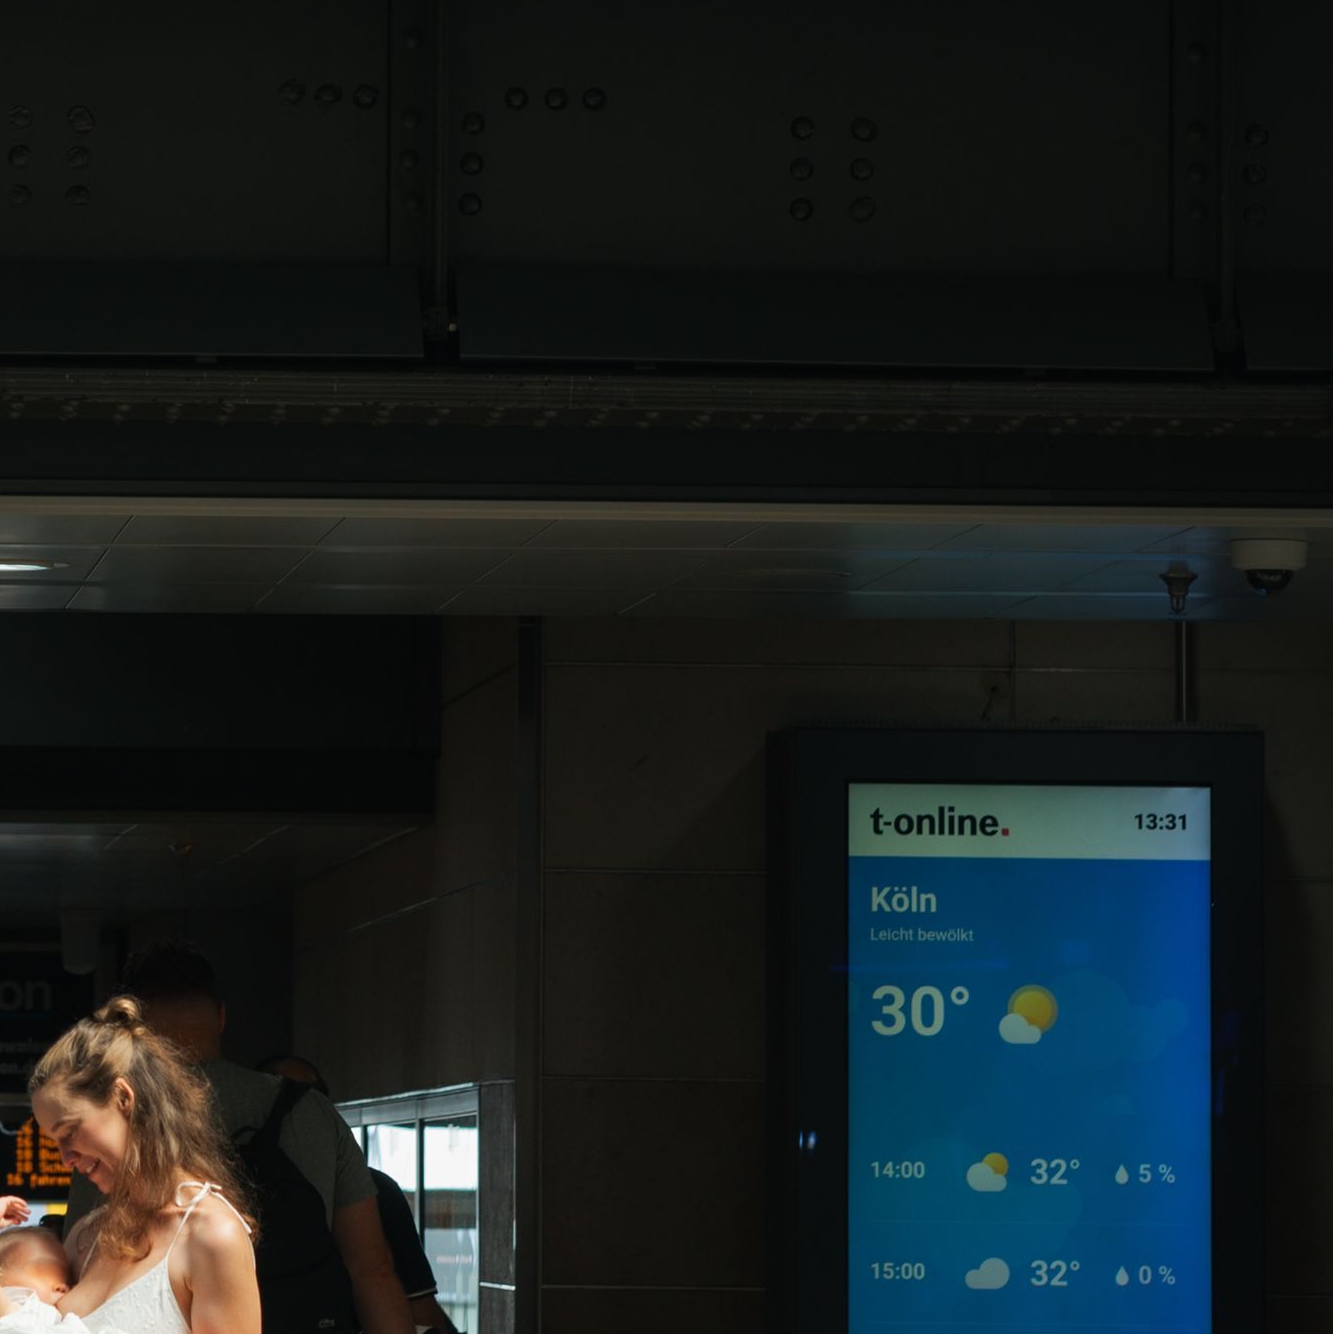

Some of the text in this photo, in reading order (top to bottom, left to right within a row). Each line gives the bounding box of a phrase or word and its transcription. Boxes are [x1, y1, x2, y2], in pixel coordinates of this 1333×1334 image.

[870, 805, 1010, 836] t-online.
[1133, 813, 1188, 831] 13:31
[870, 886, 937, 913] Köln
[870, 927, 974, 943] Leicht bewölkt
[871, 985, 970, 1037] 30°
[870, 1158, 1177, 1185] 14:00 32° 5 %
[870, 1260, 1177, 1287] 15:00 32° 0 %
